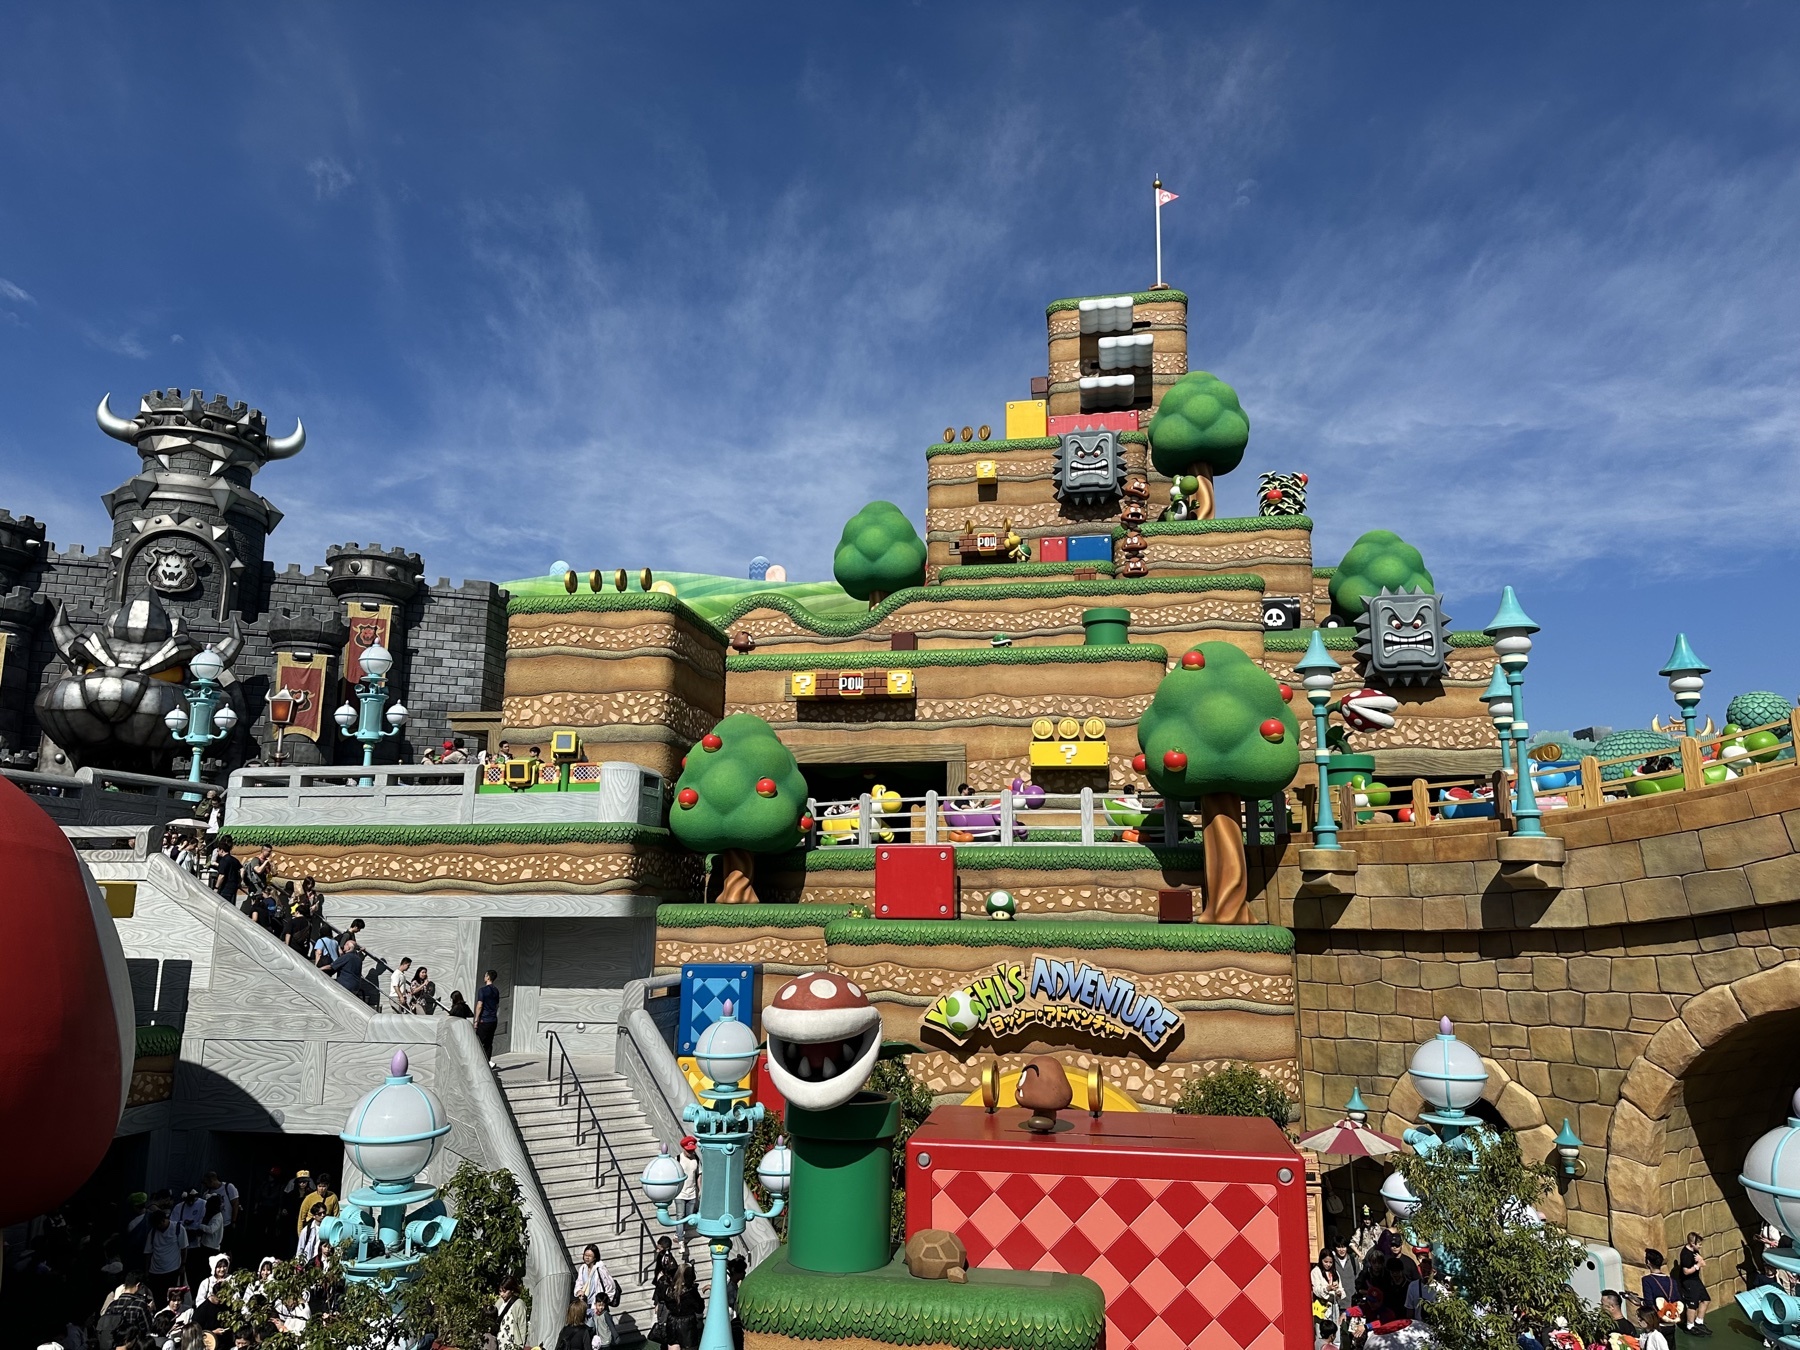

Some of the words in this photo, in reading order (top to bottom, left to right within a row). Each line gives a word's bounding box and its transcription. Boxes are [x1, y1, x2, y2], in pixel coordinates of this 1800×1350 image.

[977, 536, 997, 548] POW
[839, 677, 864, 691] POW
[1030, 957, 1179, 1043] ADVENTURE
